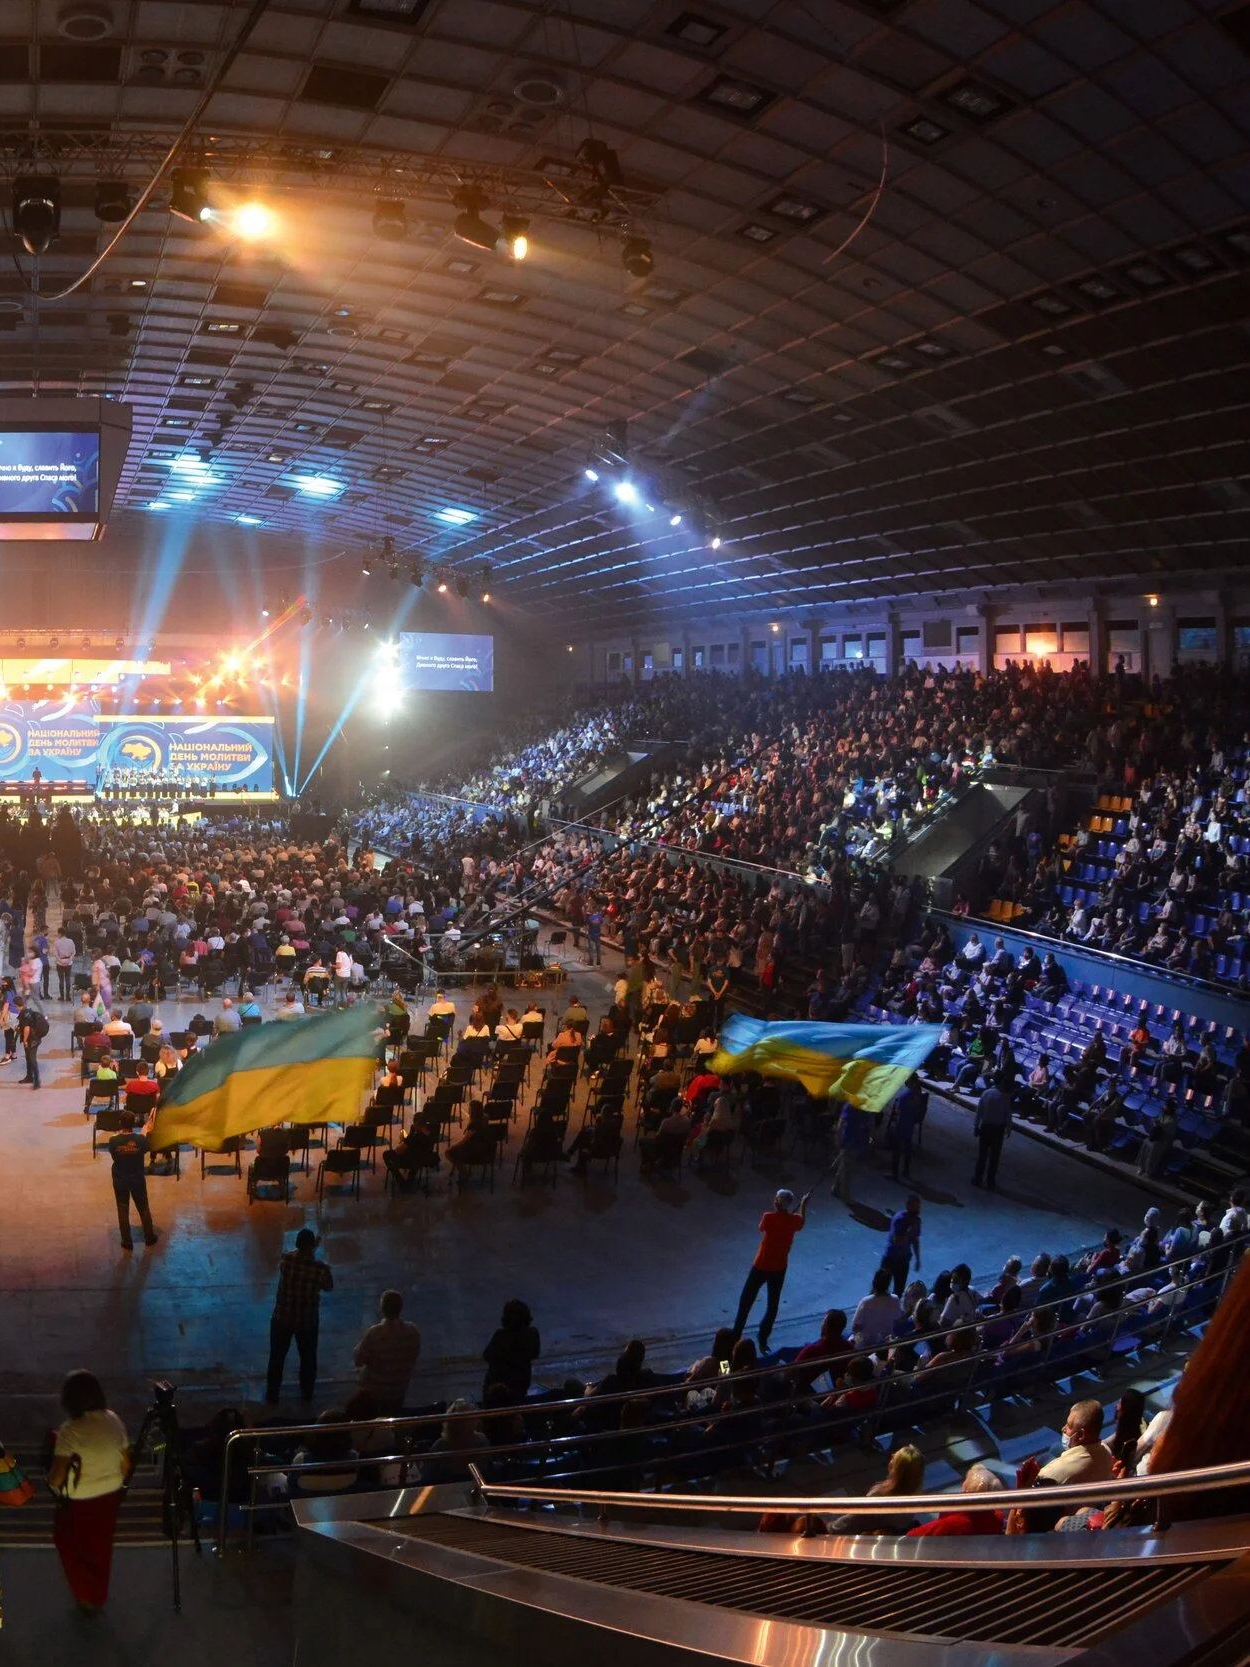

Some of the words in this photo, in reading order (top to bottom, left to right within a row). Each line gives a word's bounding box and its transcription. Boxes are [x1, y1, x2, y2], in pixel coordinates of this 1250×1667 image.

[169, 742, 252, 751] НАЦІОНАЛЬНИЙ
[43, 747, 82, 756] УКРАЇНУ
[170, 753, 198, 761] ДЕНЬ
[200, 753, 250, 761] МОЛИТВИ
[187, 761, 232, 771] УКРАЇНУ
